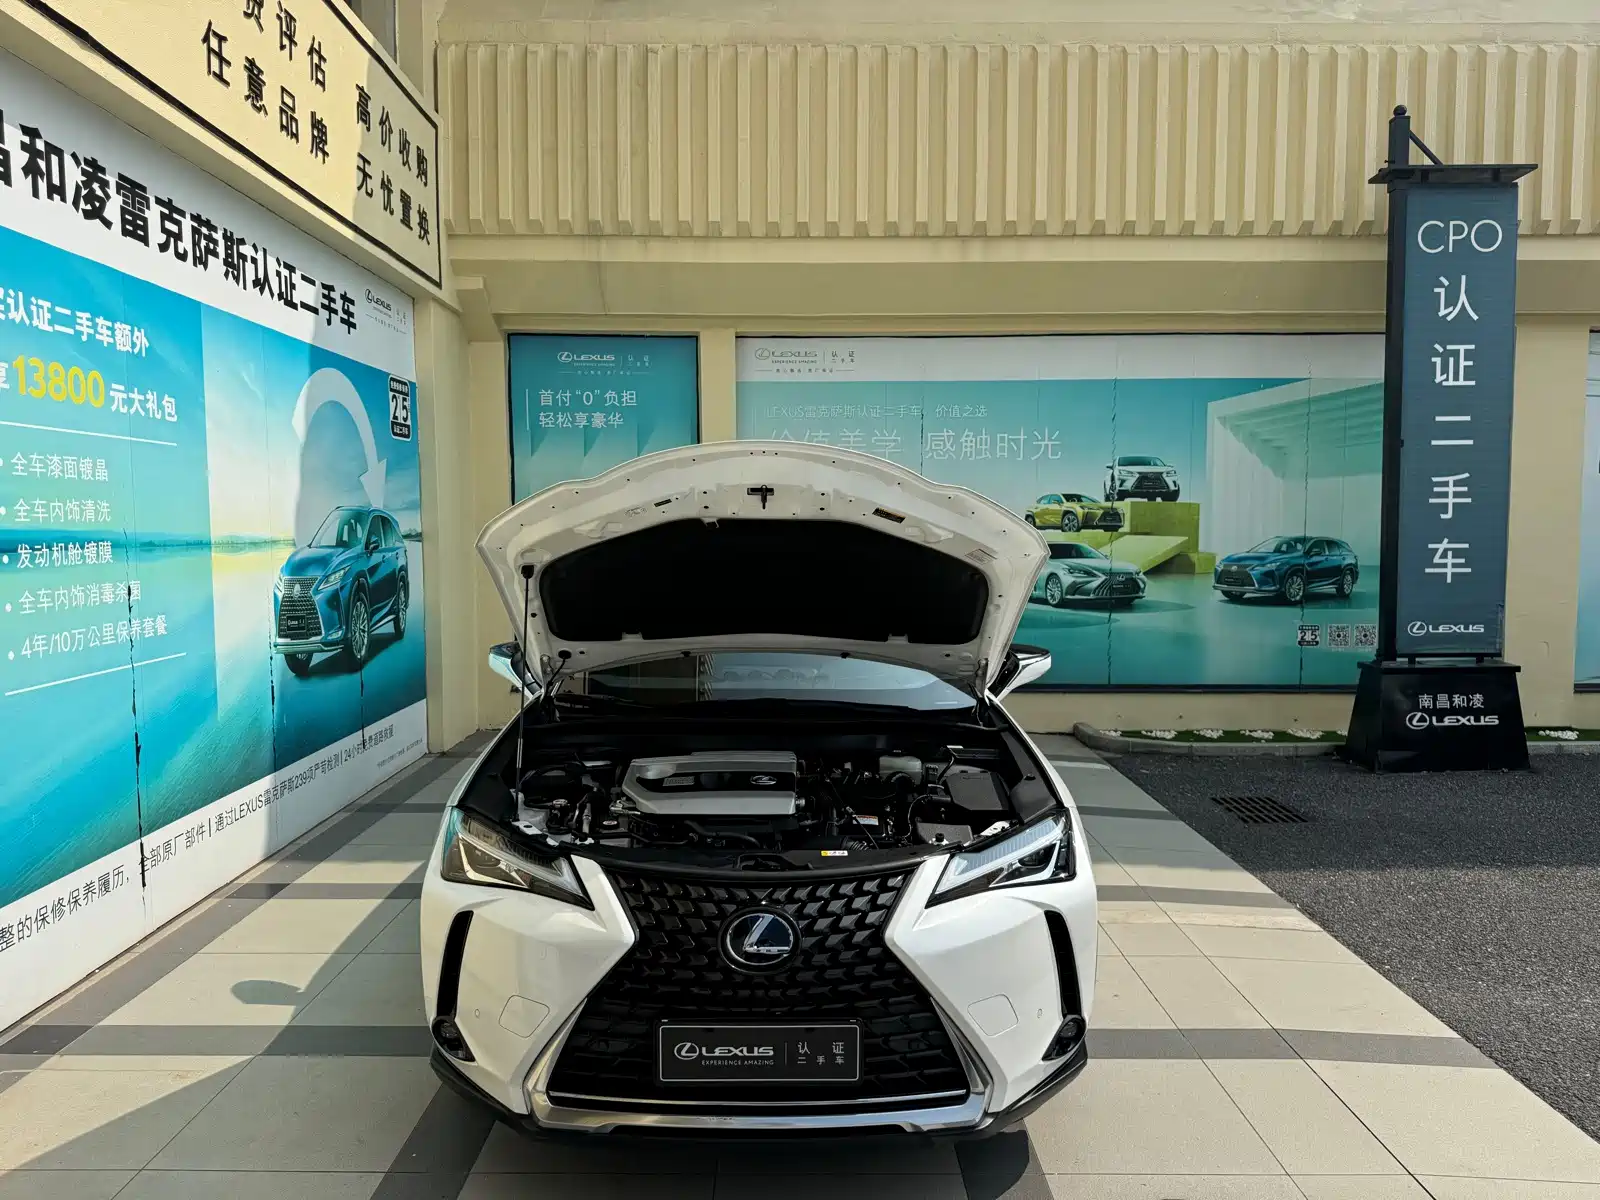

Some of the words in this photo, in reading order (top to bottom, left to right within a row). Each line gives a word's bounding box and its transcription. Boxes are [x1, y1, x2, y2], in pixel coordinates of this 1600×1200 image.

[201, 18, 330, 165] 任意品牌
[356, 151, 431, 246] 无忧置换
[354, 82, 429, 188] 高价收购
[1417, 219, 1503, 254] CPO
[0, 286, 150, 358] 认证二手车额外
[771, 350, 818, 358] LEXUS
[538, 411, 624, 429] 轻松享豪华
[1424, 274, 1480, 584] 认证二手车
[925, 426, 1063, 461] 感触时光
[11, 451, 109, 483] 全车漆面镀晶
[13, 498, 112, 523] 全车内饰清洗
[16, 541, 113, 569] 发动机舱镀膜
[18, 579, 141, 614] 全车内饰消毒杀菌
[1429, 624, 1485, 633] LEXUS
[1418, 692, 1485, 710] 南昌和凌
[1432, 714, 1500, 726] LEXUS
[701, 1046, 774, 1056] LEXUS
